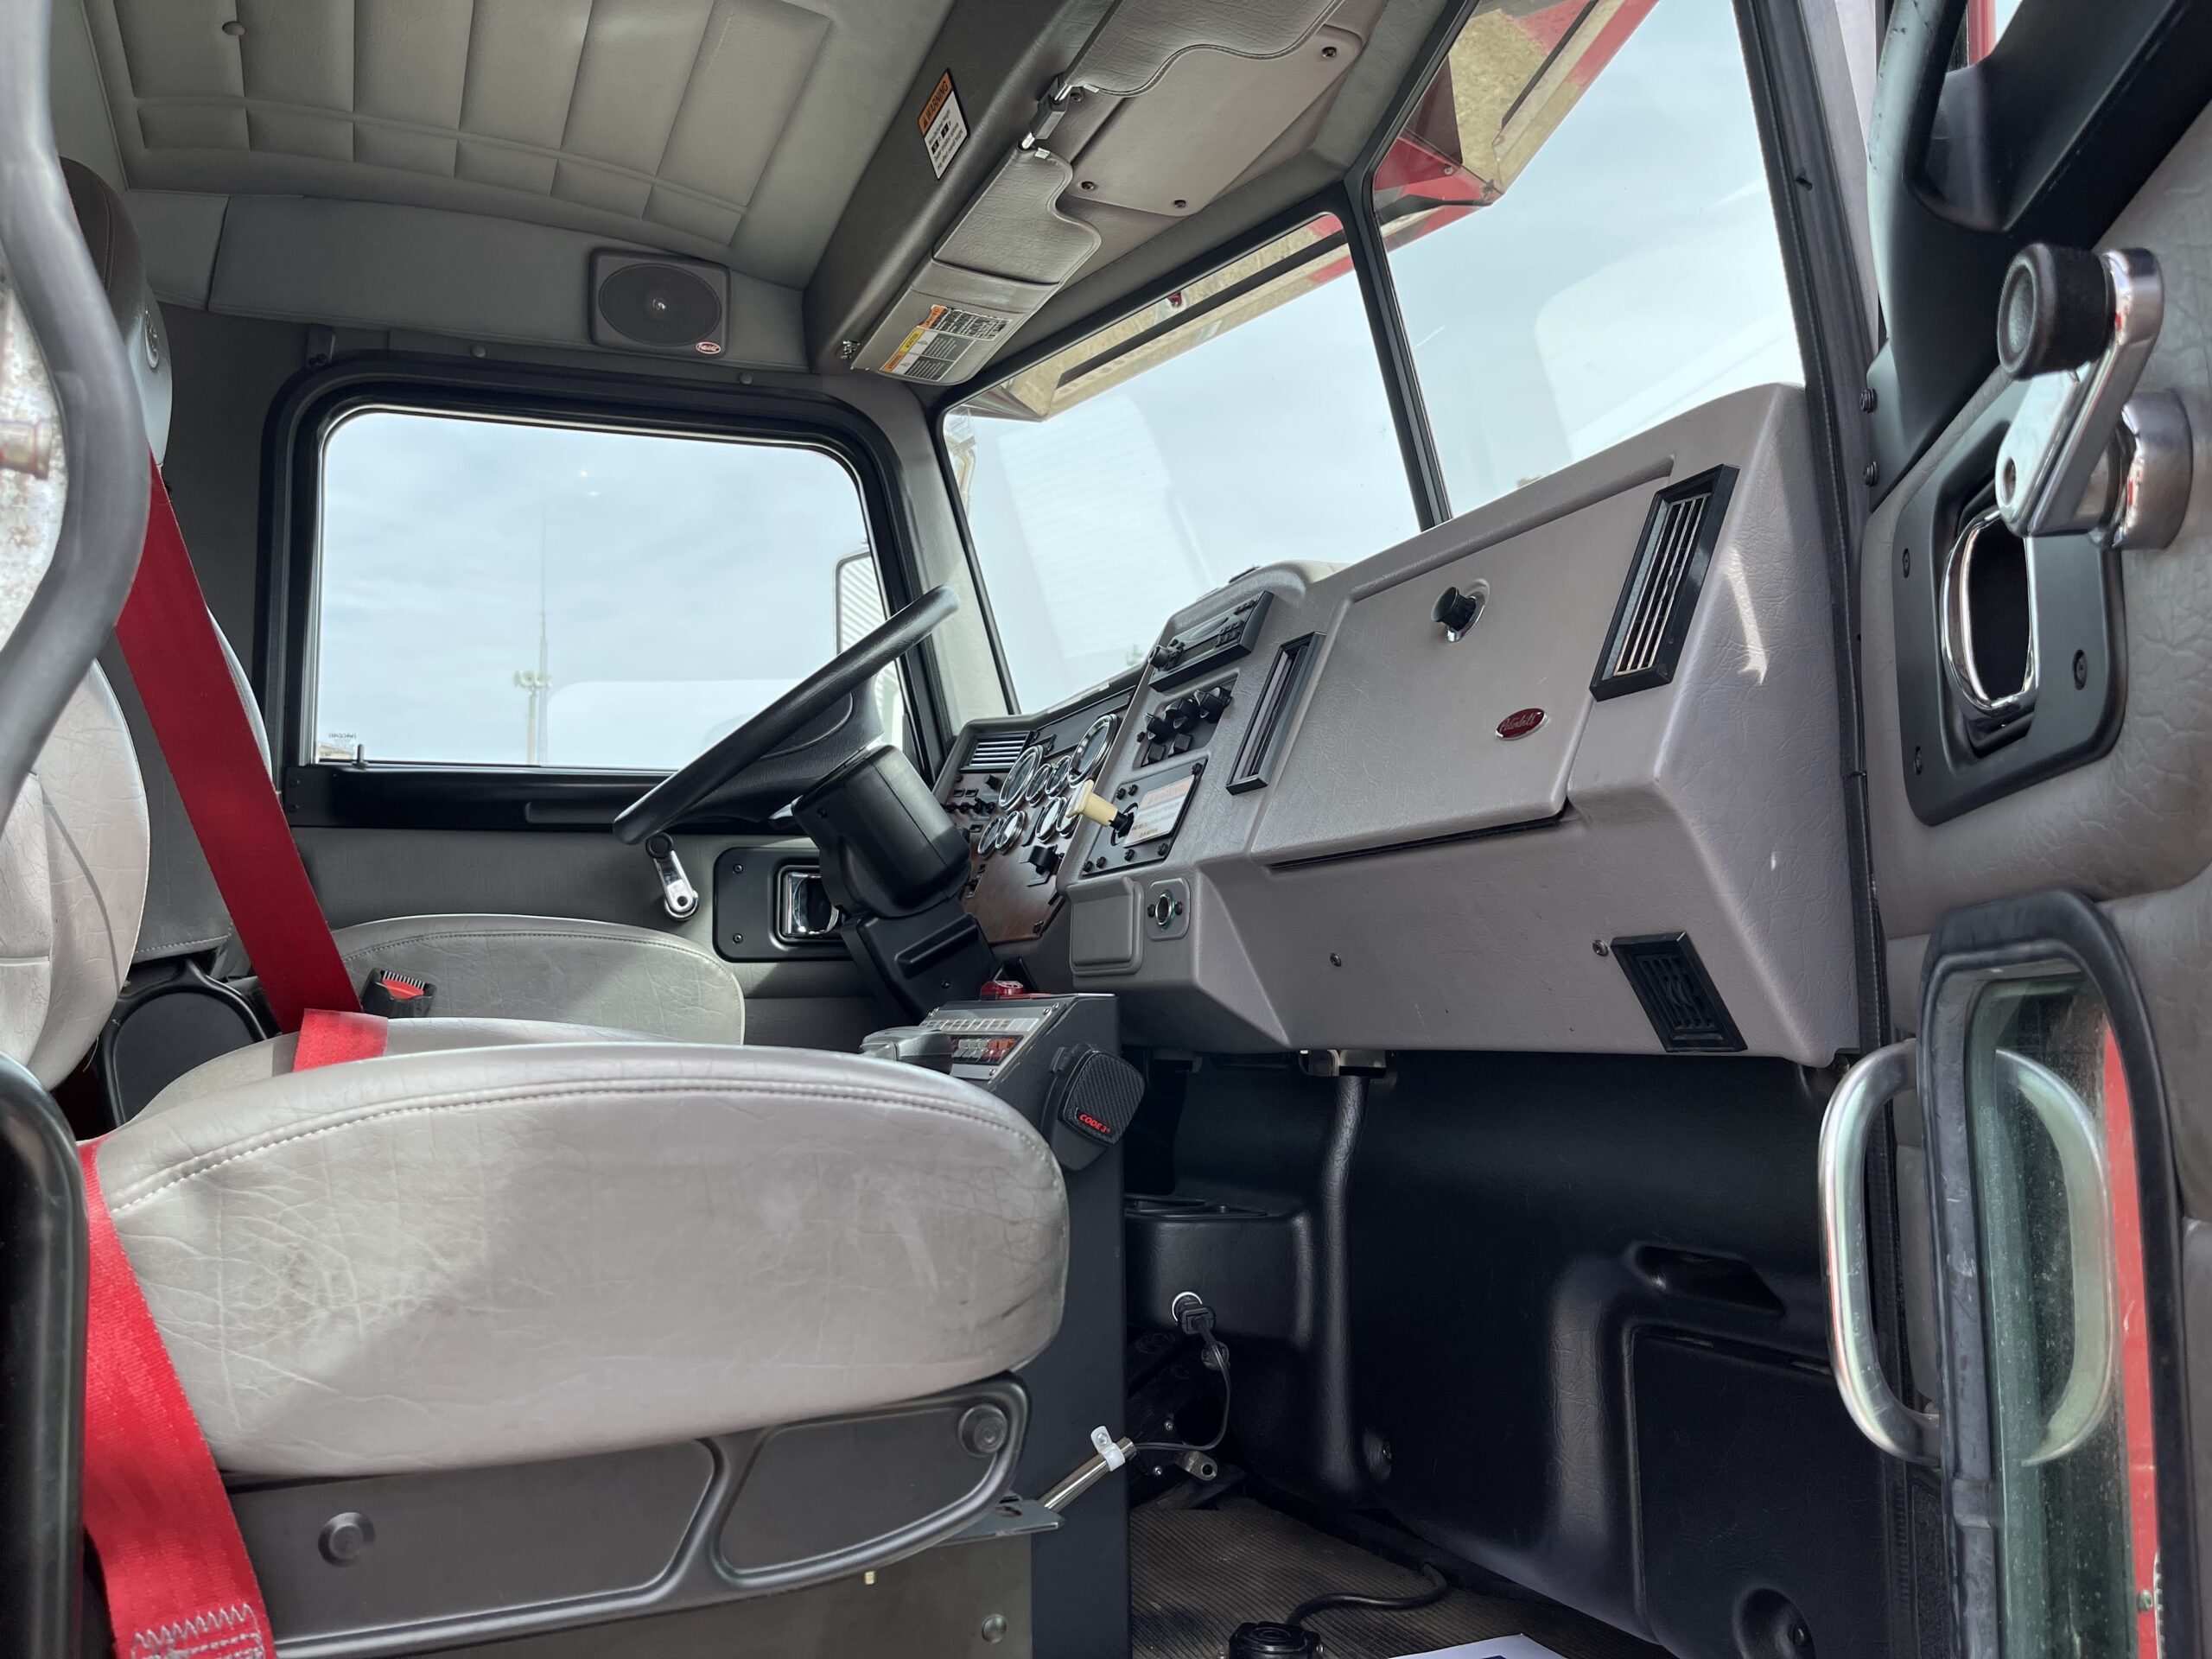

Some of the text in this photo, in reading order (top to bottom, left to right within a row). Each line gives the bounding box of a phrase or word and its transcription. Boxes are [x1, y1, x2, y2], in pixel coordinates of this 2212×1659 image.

[925, 80, 949, 121] WARNING
[1499, 713, 1536, 733] Peterbilt
[1079, 1114, 1102, 1129] CODE
